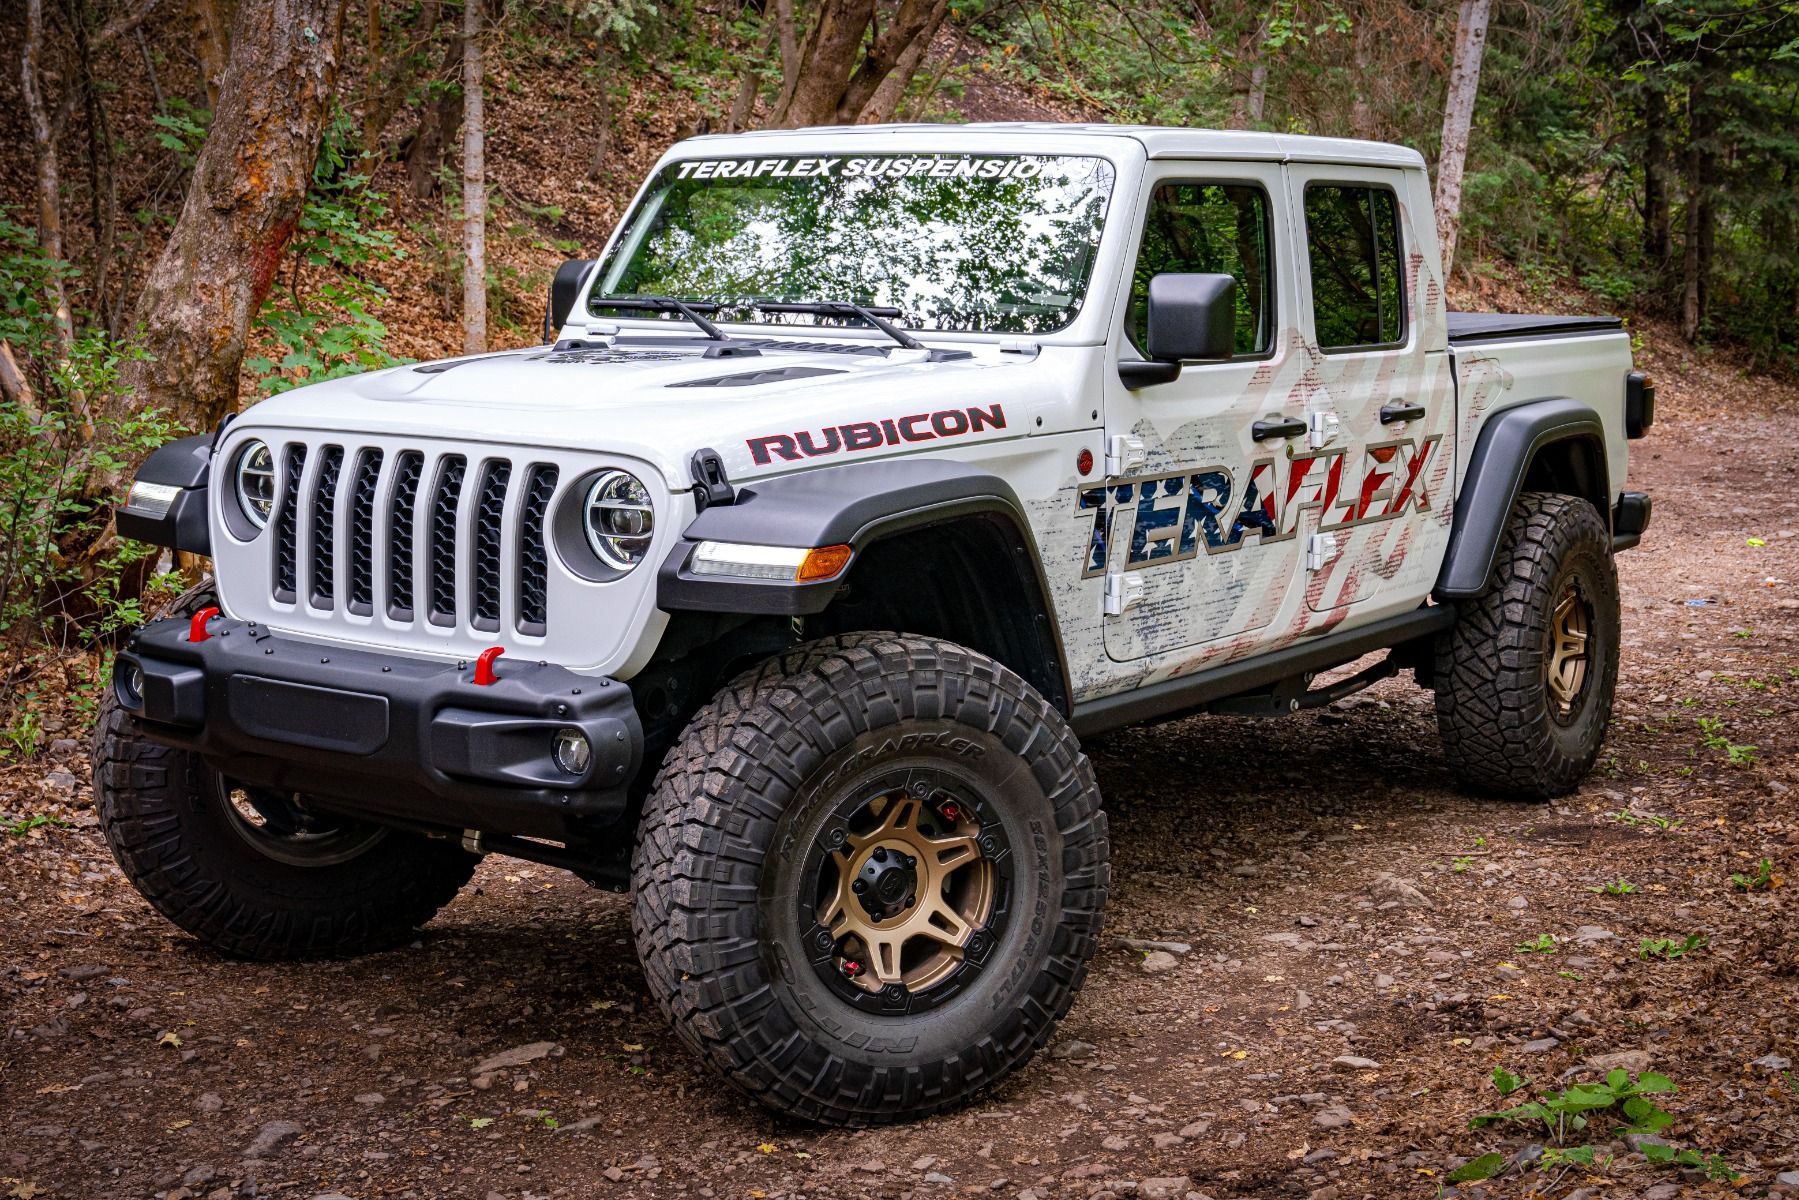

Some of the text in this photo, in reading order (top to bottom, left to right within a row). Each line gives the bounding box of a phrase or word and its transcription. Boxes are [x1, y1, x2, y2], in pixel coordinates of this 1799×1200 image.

[677, 159, 840, 180] TERAFLEX
[746, 404, 1007, 466] RUBICON
[1074, 434, 1443, 580] TERAFLEX
[838, 730, 985, 773] GRAPPLER
[772, 942, 918, 1054] NITTO
